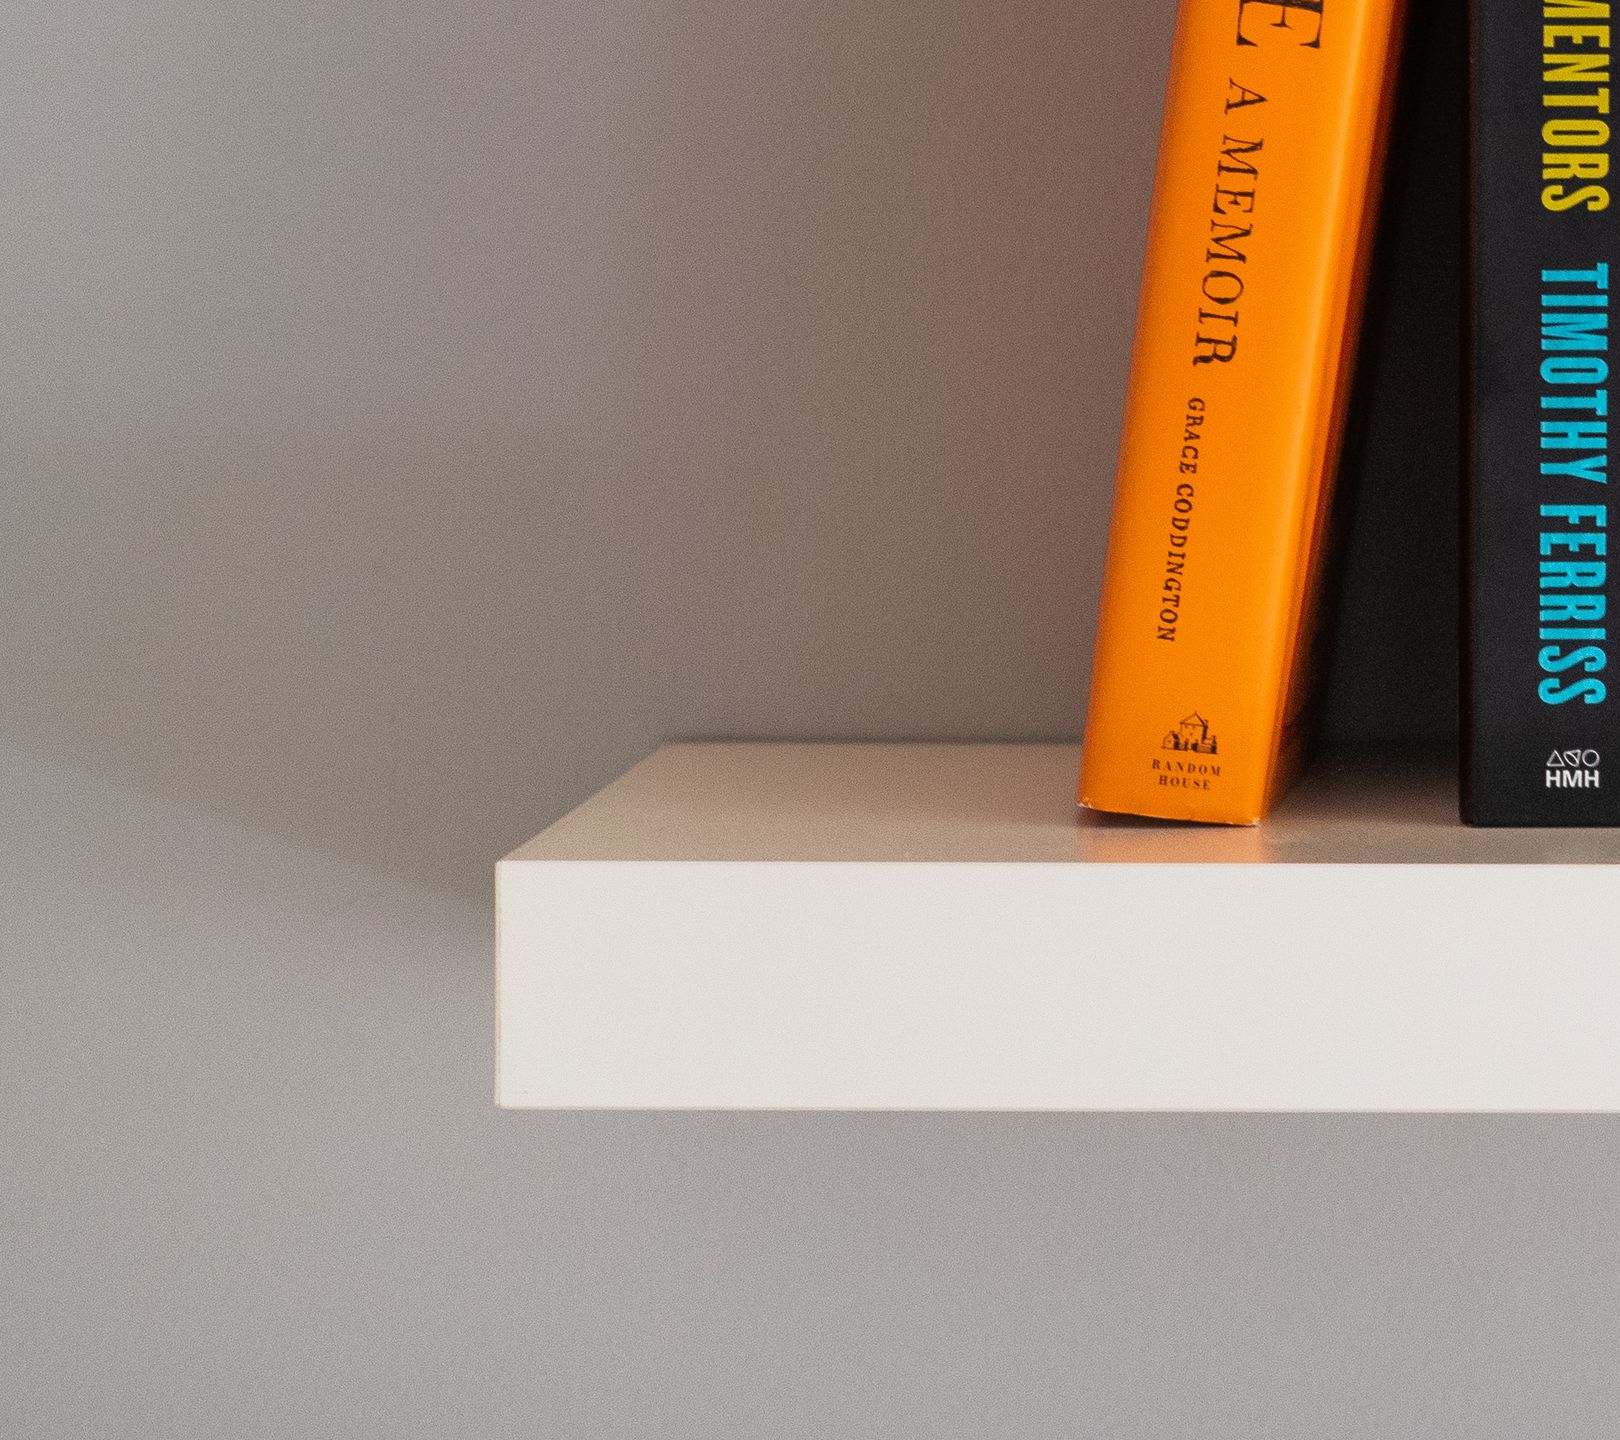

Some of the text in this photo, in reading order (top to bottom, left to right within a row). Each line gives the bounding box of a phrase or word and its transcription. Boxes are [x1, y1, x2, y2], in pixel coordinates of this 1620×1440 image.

[1224, 77, 1268, 115] A
[1192, 134, 1264, 366] MEMOIR
[1538, 263, 1608, 705] TIMOTHY FERRISS
[1157, 397, 1205, 642] GRACE CODDINGTON
[1152, 759, 1220, 776] RANDOM
[1159, 775, 1209, 790] HOUSE
[1545, 770, 1599, 788] HMH
